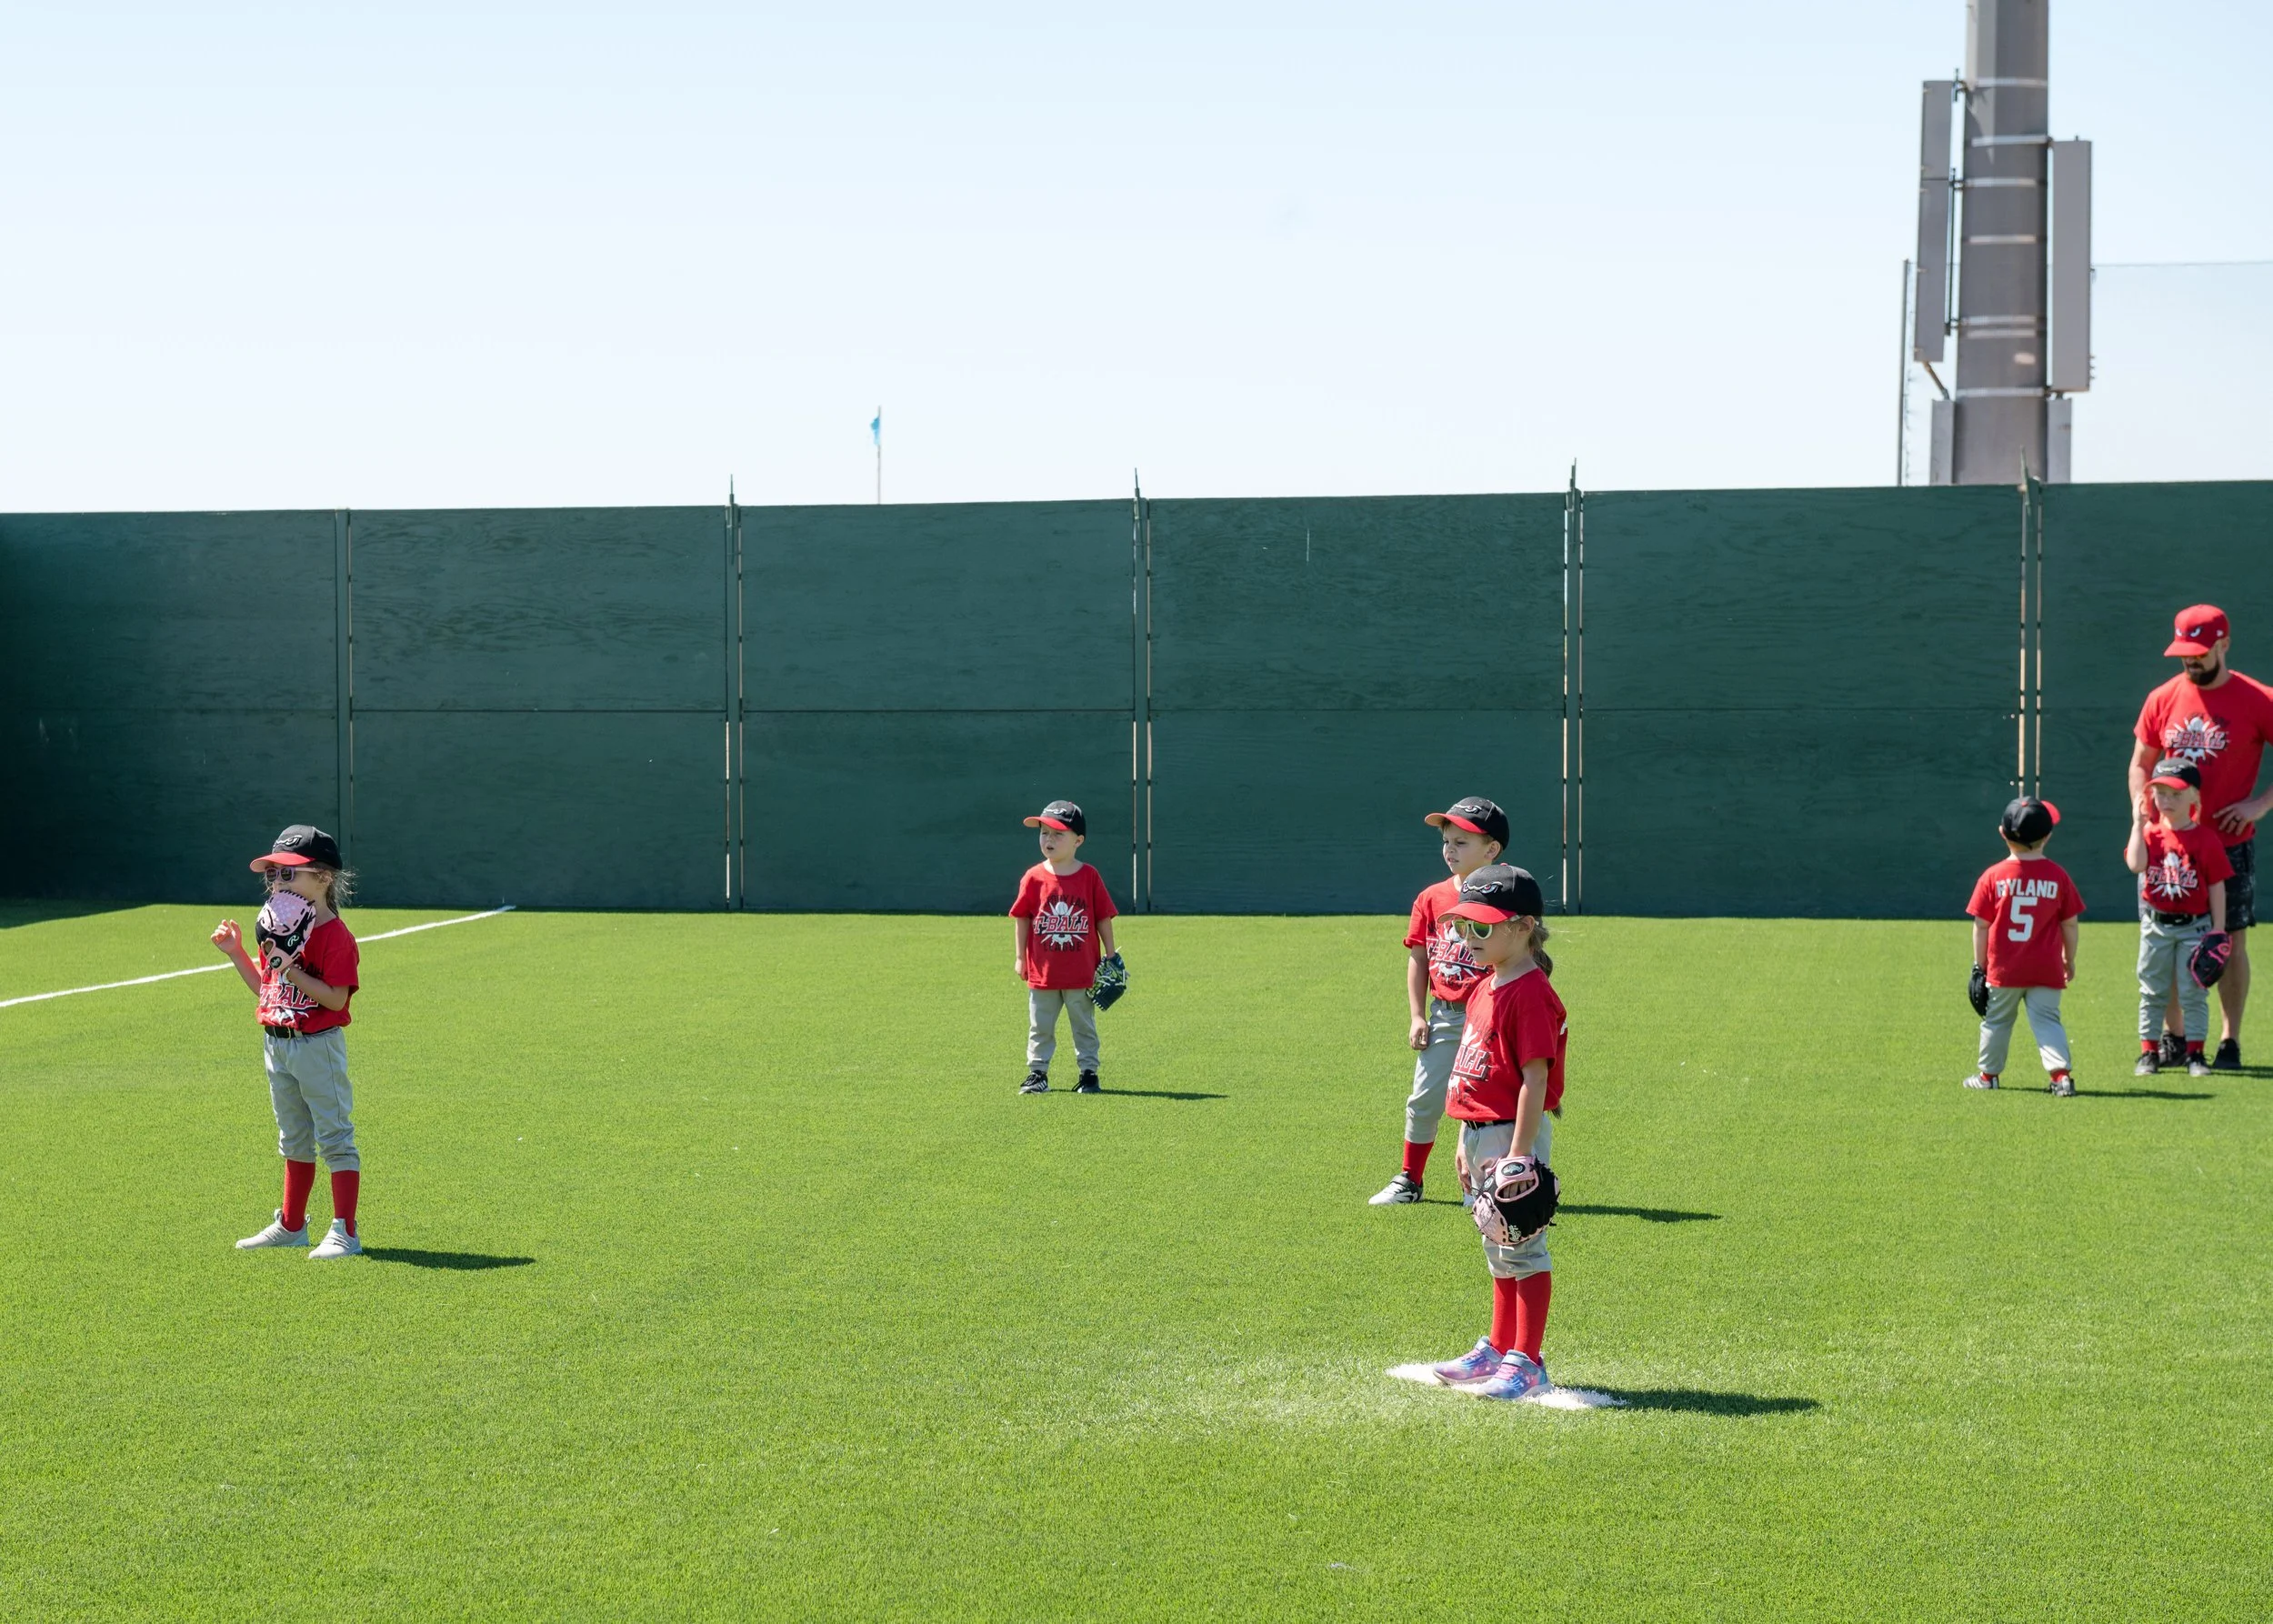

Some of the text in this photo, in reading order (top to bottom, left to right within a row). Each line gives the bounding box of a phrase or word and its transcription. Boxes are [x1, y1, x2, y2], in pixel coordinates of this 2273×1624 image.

[1034, 915, 1089, 935] T-BALL
[2008, 896, 2038, 942] 5
[1426, 937, 1486, 970] T-BAL
